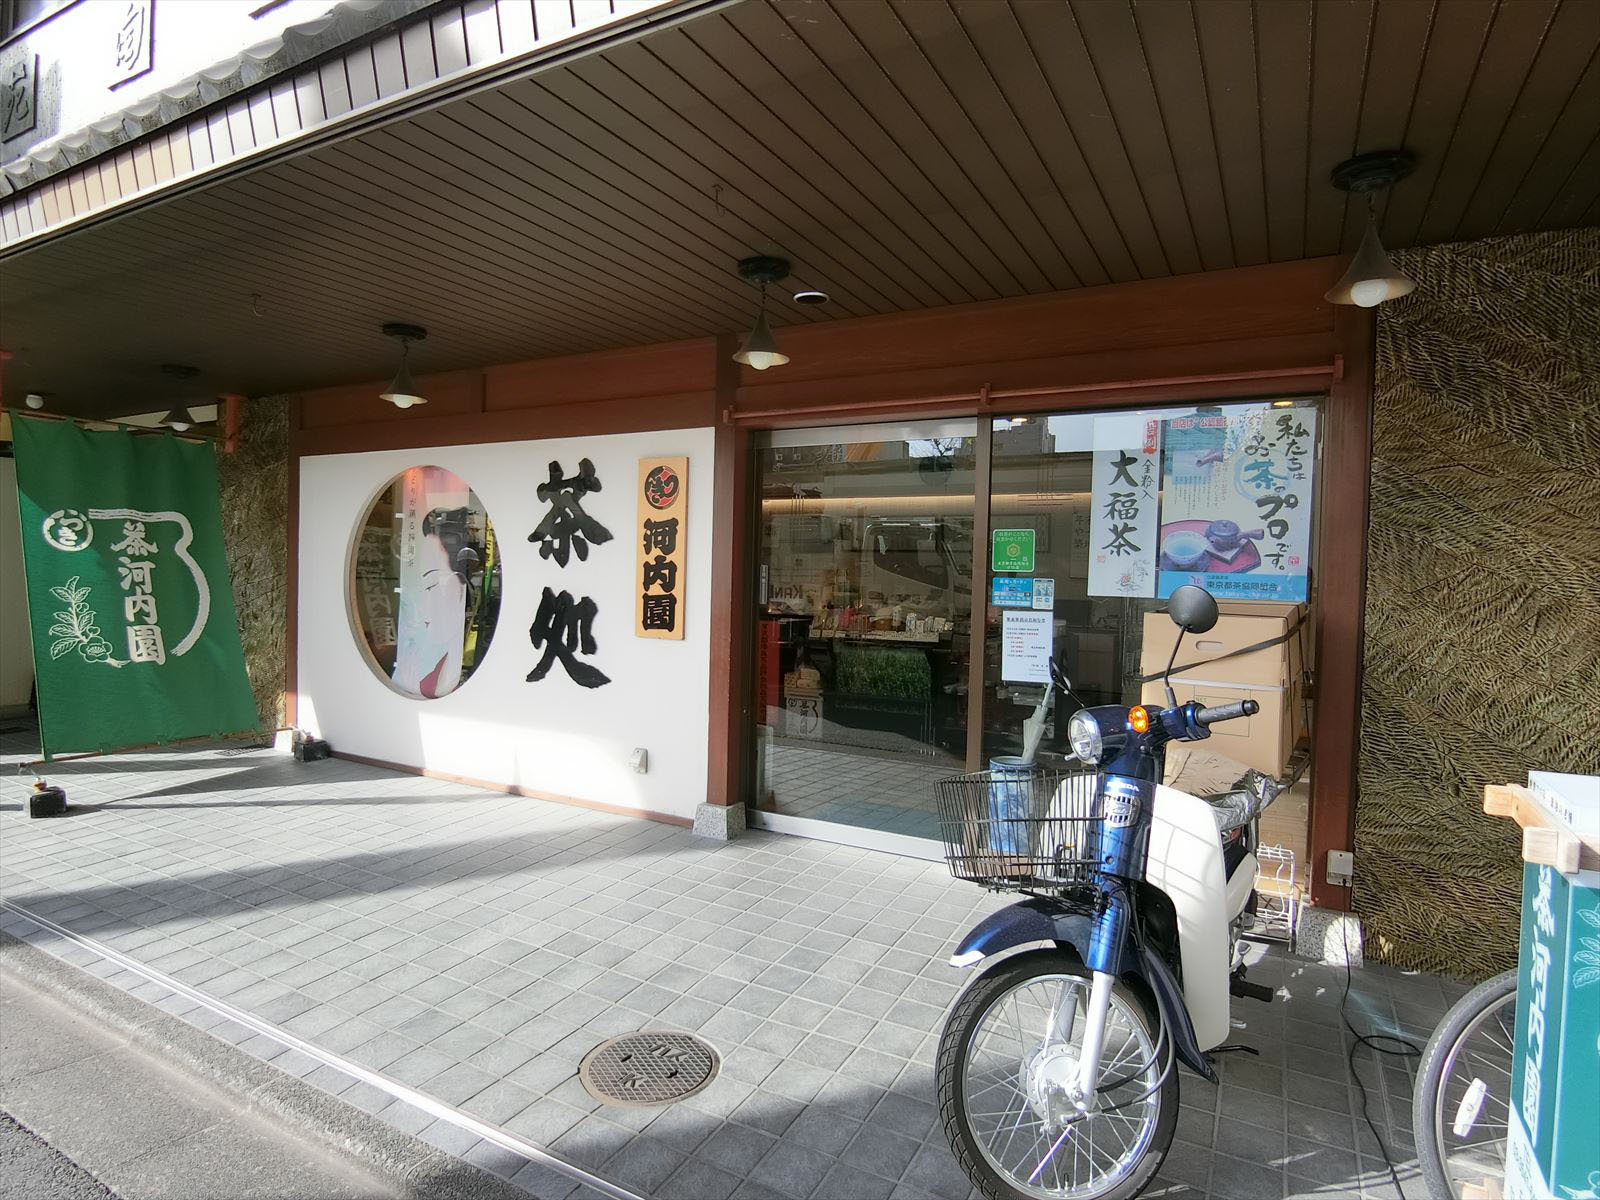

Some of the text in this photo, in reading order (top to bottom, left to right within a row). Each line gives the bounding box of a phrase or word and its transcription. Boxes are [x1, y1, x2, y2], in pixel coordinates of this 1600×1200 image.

[1101, 449, 1142, 557] 大福茶
[1140, 458, 1157, 501] 金粉入
[1275, 413, 1311, 481] 私たちは
[110, 520, 167, 665] 茶河内園
[526, 456, 614, 689] 茶処
[642, 517, 680, 633] 河内園
